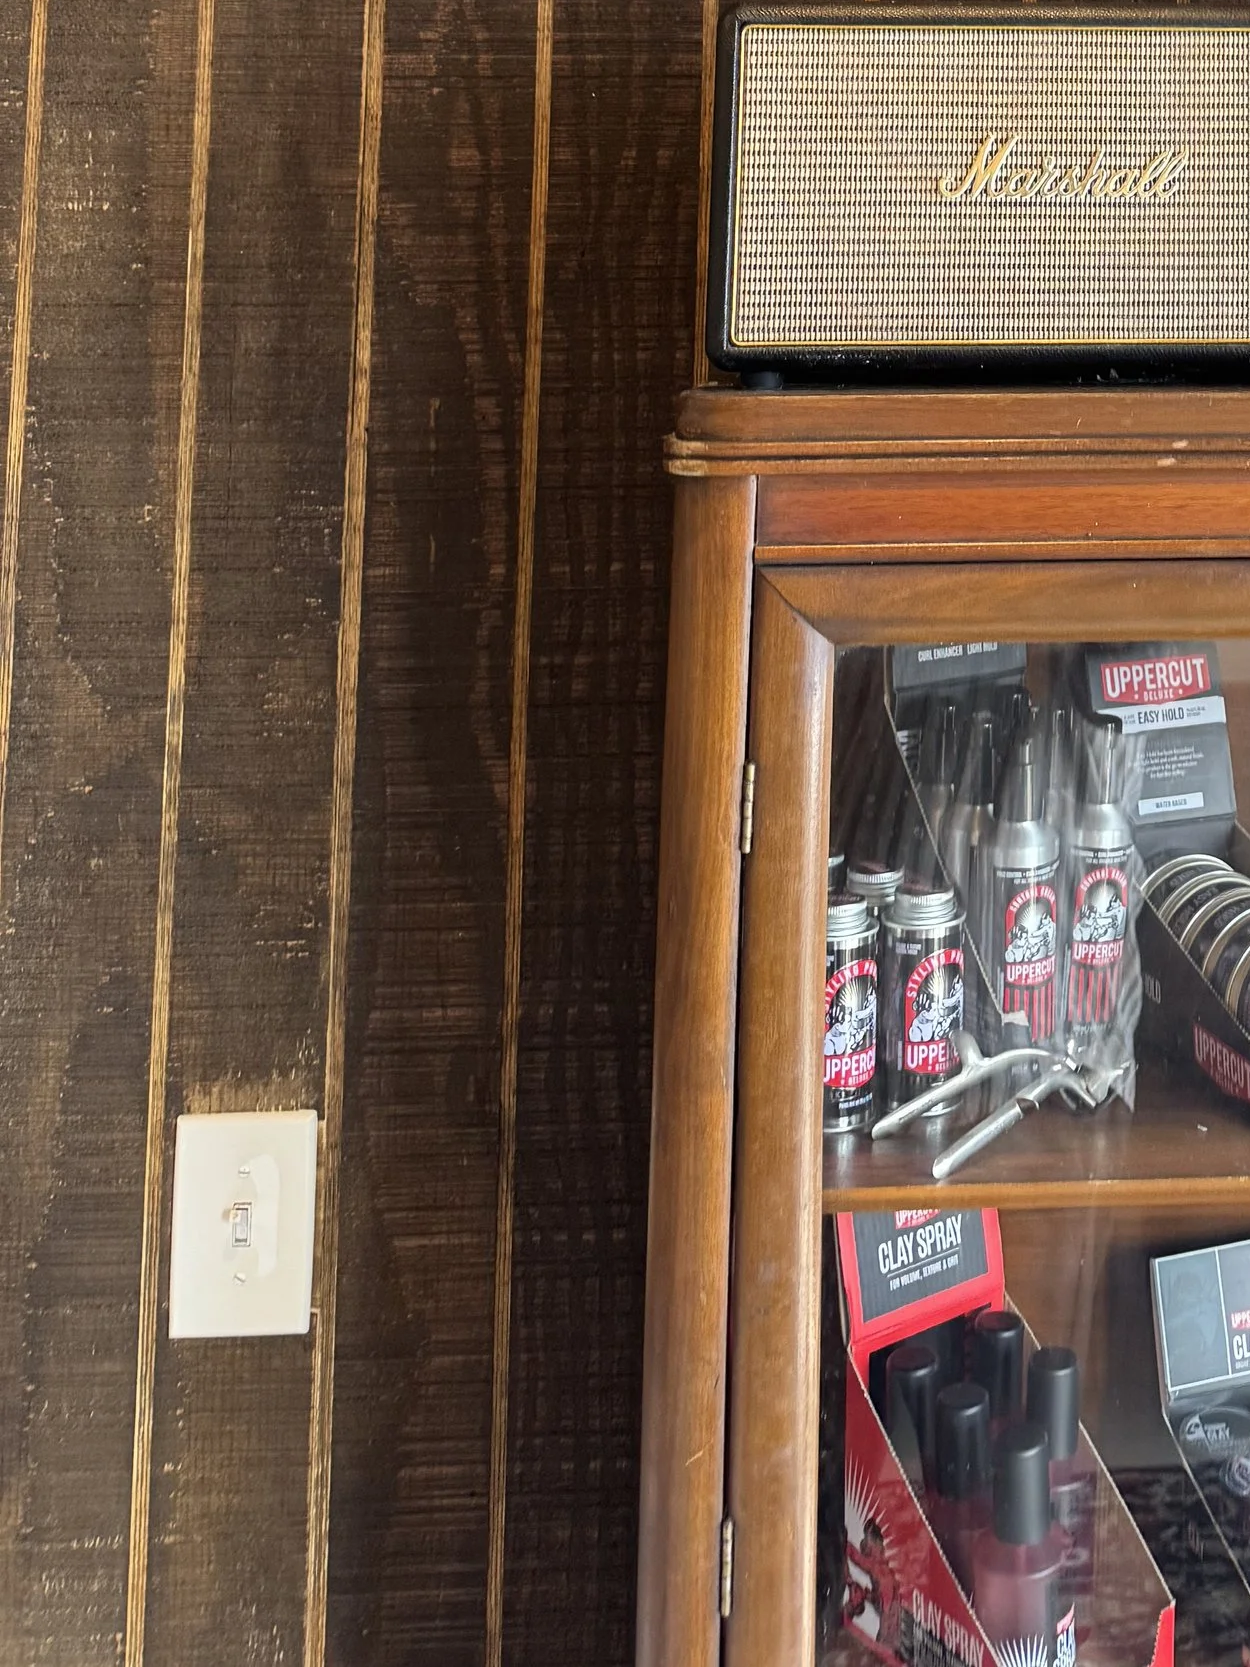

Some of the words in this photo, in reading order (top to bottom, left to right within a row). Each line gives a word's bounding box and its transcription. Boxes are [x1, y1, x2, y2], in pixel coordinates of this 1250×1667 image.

[939, 133, 1189, 201] Marshall
[1105, 657, 1205, 698] UPPERCUT
[1143, 689, 1174, 701] DELUXE
[1138, 710, 1161, 724] EASY
[1162, 707, 1184, 722] HOLD
[1006, 956, 1055, 982] UPPERCUT
[1074, 941, 1124, 961] UPPERCUT
[907, 951, 947, 998] STYLING
[878, 1232, 914, 1274] CLAY
[916, 1214, 962, 1258] SPRAY
[912, 1588, 942, 1641] CLAY
[943, 1614, 985, 1667] SPRAY
